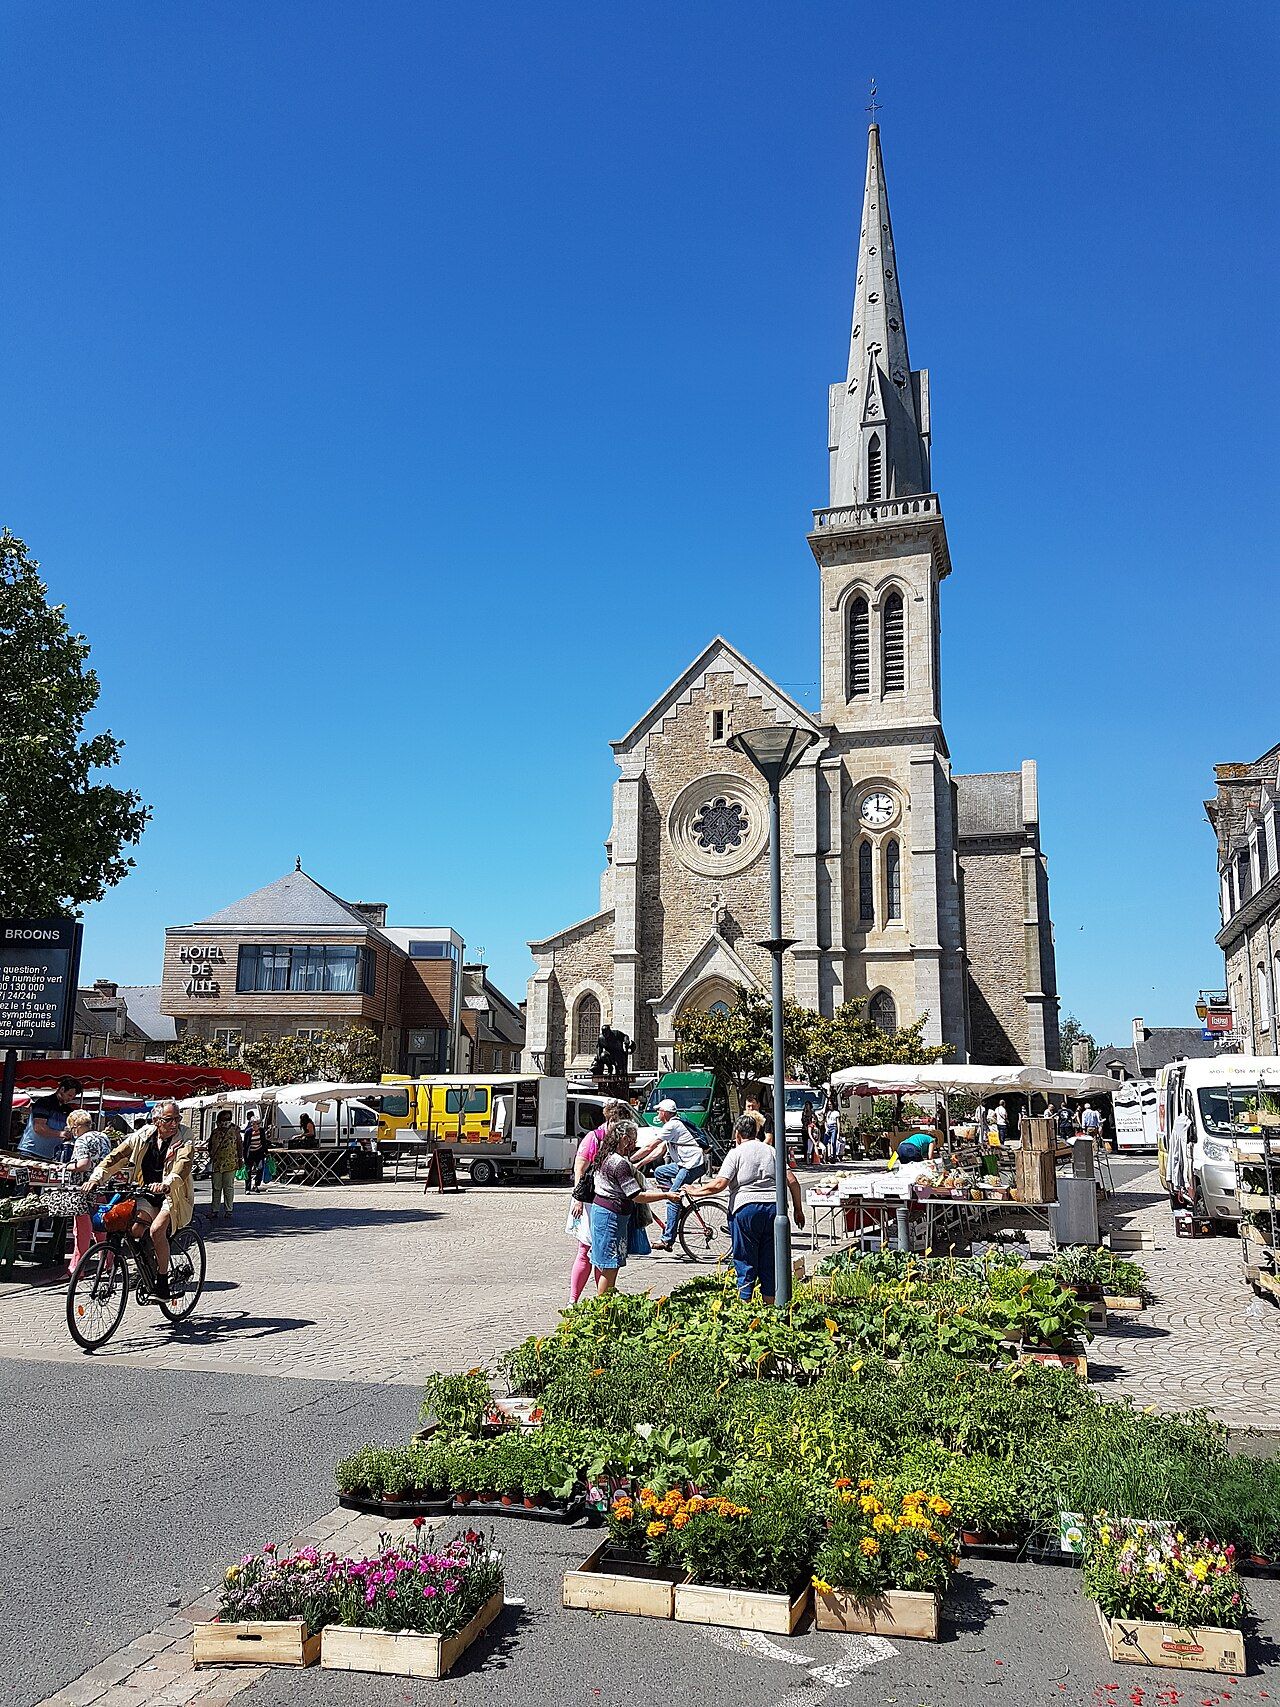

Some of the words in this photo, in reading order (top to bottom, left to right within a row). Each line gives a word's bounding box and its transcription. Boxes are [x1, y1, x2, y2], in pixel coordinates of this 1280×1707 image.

[5, 929, 60, 940] BROONS
[178, 946, 223, 959] HOTEL
[3, 966, 40, 975] question
[42, 966, 48, 974] ?
[190, 963, 209, 975] DE
[2, 974, 10, 982] le
[12, 974, 45, 983] numéro
[46, 975, 63, 983] vert
[10, 983, 26, 991] 130
[28, 983, 45, 992] 000
[181, 980, 217, 992] VILLE
[7, 991, 37, 1000] 24/24h
[21, 1002, 32, 1010] 15
[33, 1003, 57, 1011] qu'en
[1, 1011, 52, 1019] symptômes
[16, 1020, 56, 1028] difficultés
